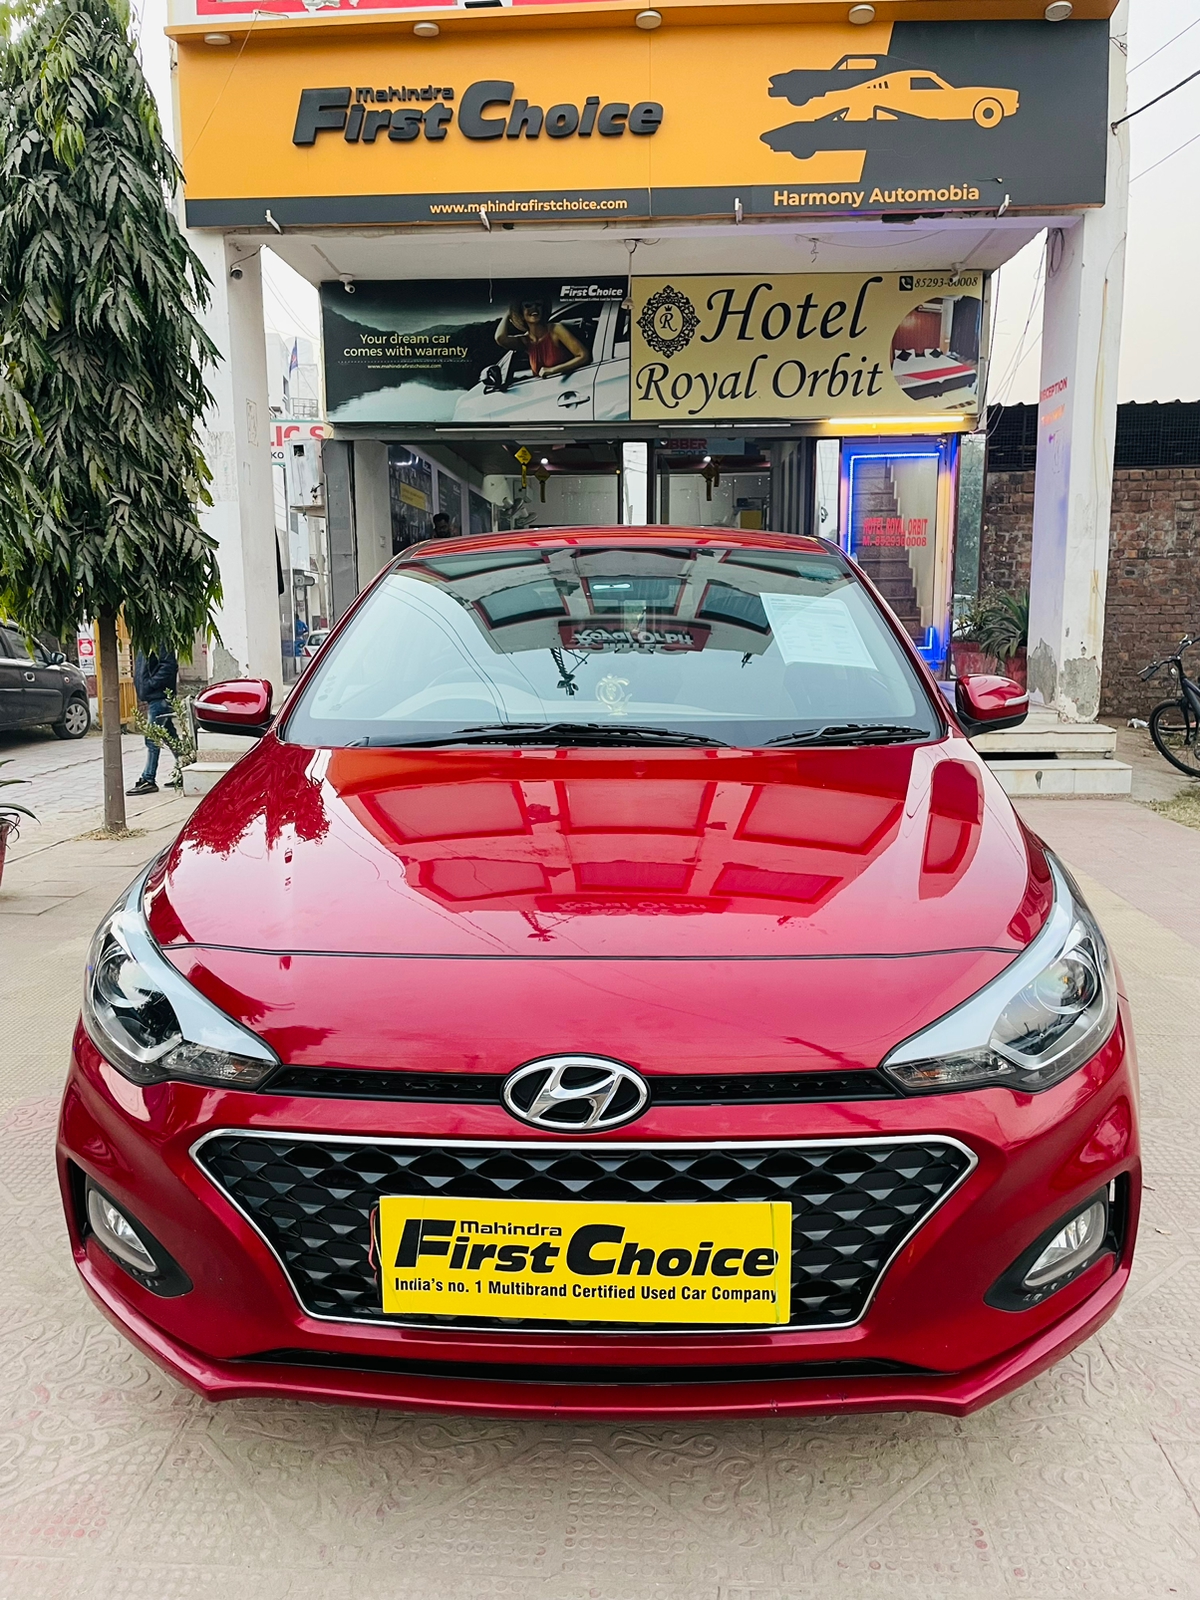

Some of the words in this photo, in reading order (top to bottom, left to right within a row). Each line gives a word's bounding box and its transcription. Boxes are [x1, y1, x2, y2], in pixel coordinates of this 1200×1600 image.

[356, 85, 454, 103] Mahindra
[292, 86, 454, 147] First
[458, 80, 664, 139] Choice
[773, 190, 865, 208] Harmony
[869, 183, 980, 203] Automobia
[430, 198, 628, 213] www.mahindrafirstchoice.com
[560, 285, 588, 297] First
[588, 285, 623, 296] Choice
[700, 276, 884, 343] Hotel
[360, 334, 387, 345] Your
[390, 333, 429, 344] dream
[432, 335, 451, 344] car
[343, 347, 383, 357] comes
[385, 346, 412, 356] with
[415, 346, 468, 358] warranty
[636, 354, 768, 415] Royal
[772, 352, 883, 399] Orbit
[863, 517, 884, 535] HOTEL
[886, 517, 905, 535] ROYAL
[908, 518, 928, 536] ORBIT
[460, 1220, 562, 1236] Mahindra
[394, 1218, 561, 1273] First
[566, 1224, 780, 1276] Choice
[448, 1280, 469, 1293] no.
[475, 1280, 482, 1293] 1
[488, 1281, 567, 1297] Multibrand
[572, 1284, 635, 1299] Certified
[641, 1286, 676, 1300] Used
[681, 1286, 706, 1300] Car
[712, 1286, 776, 1303] Company
